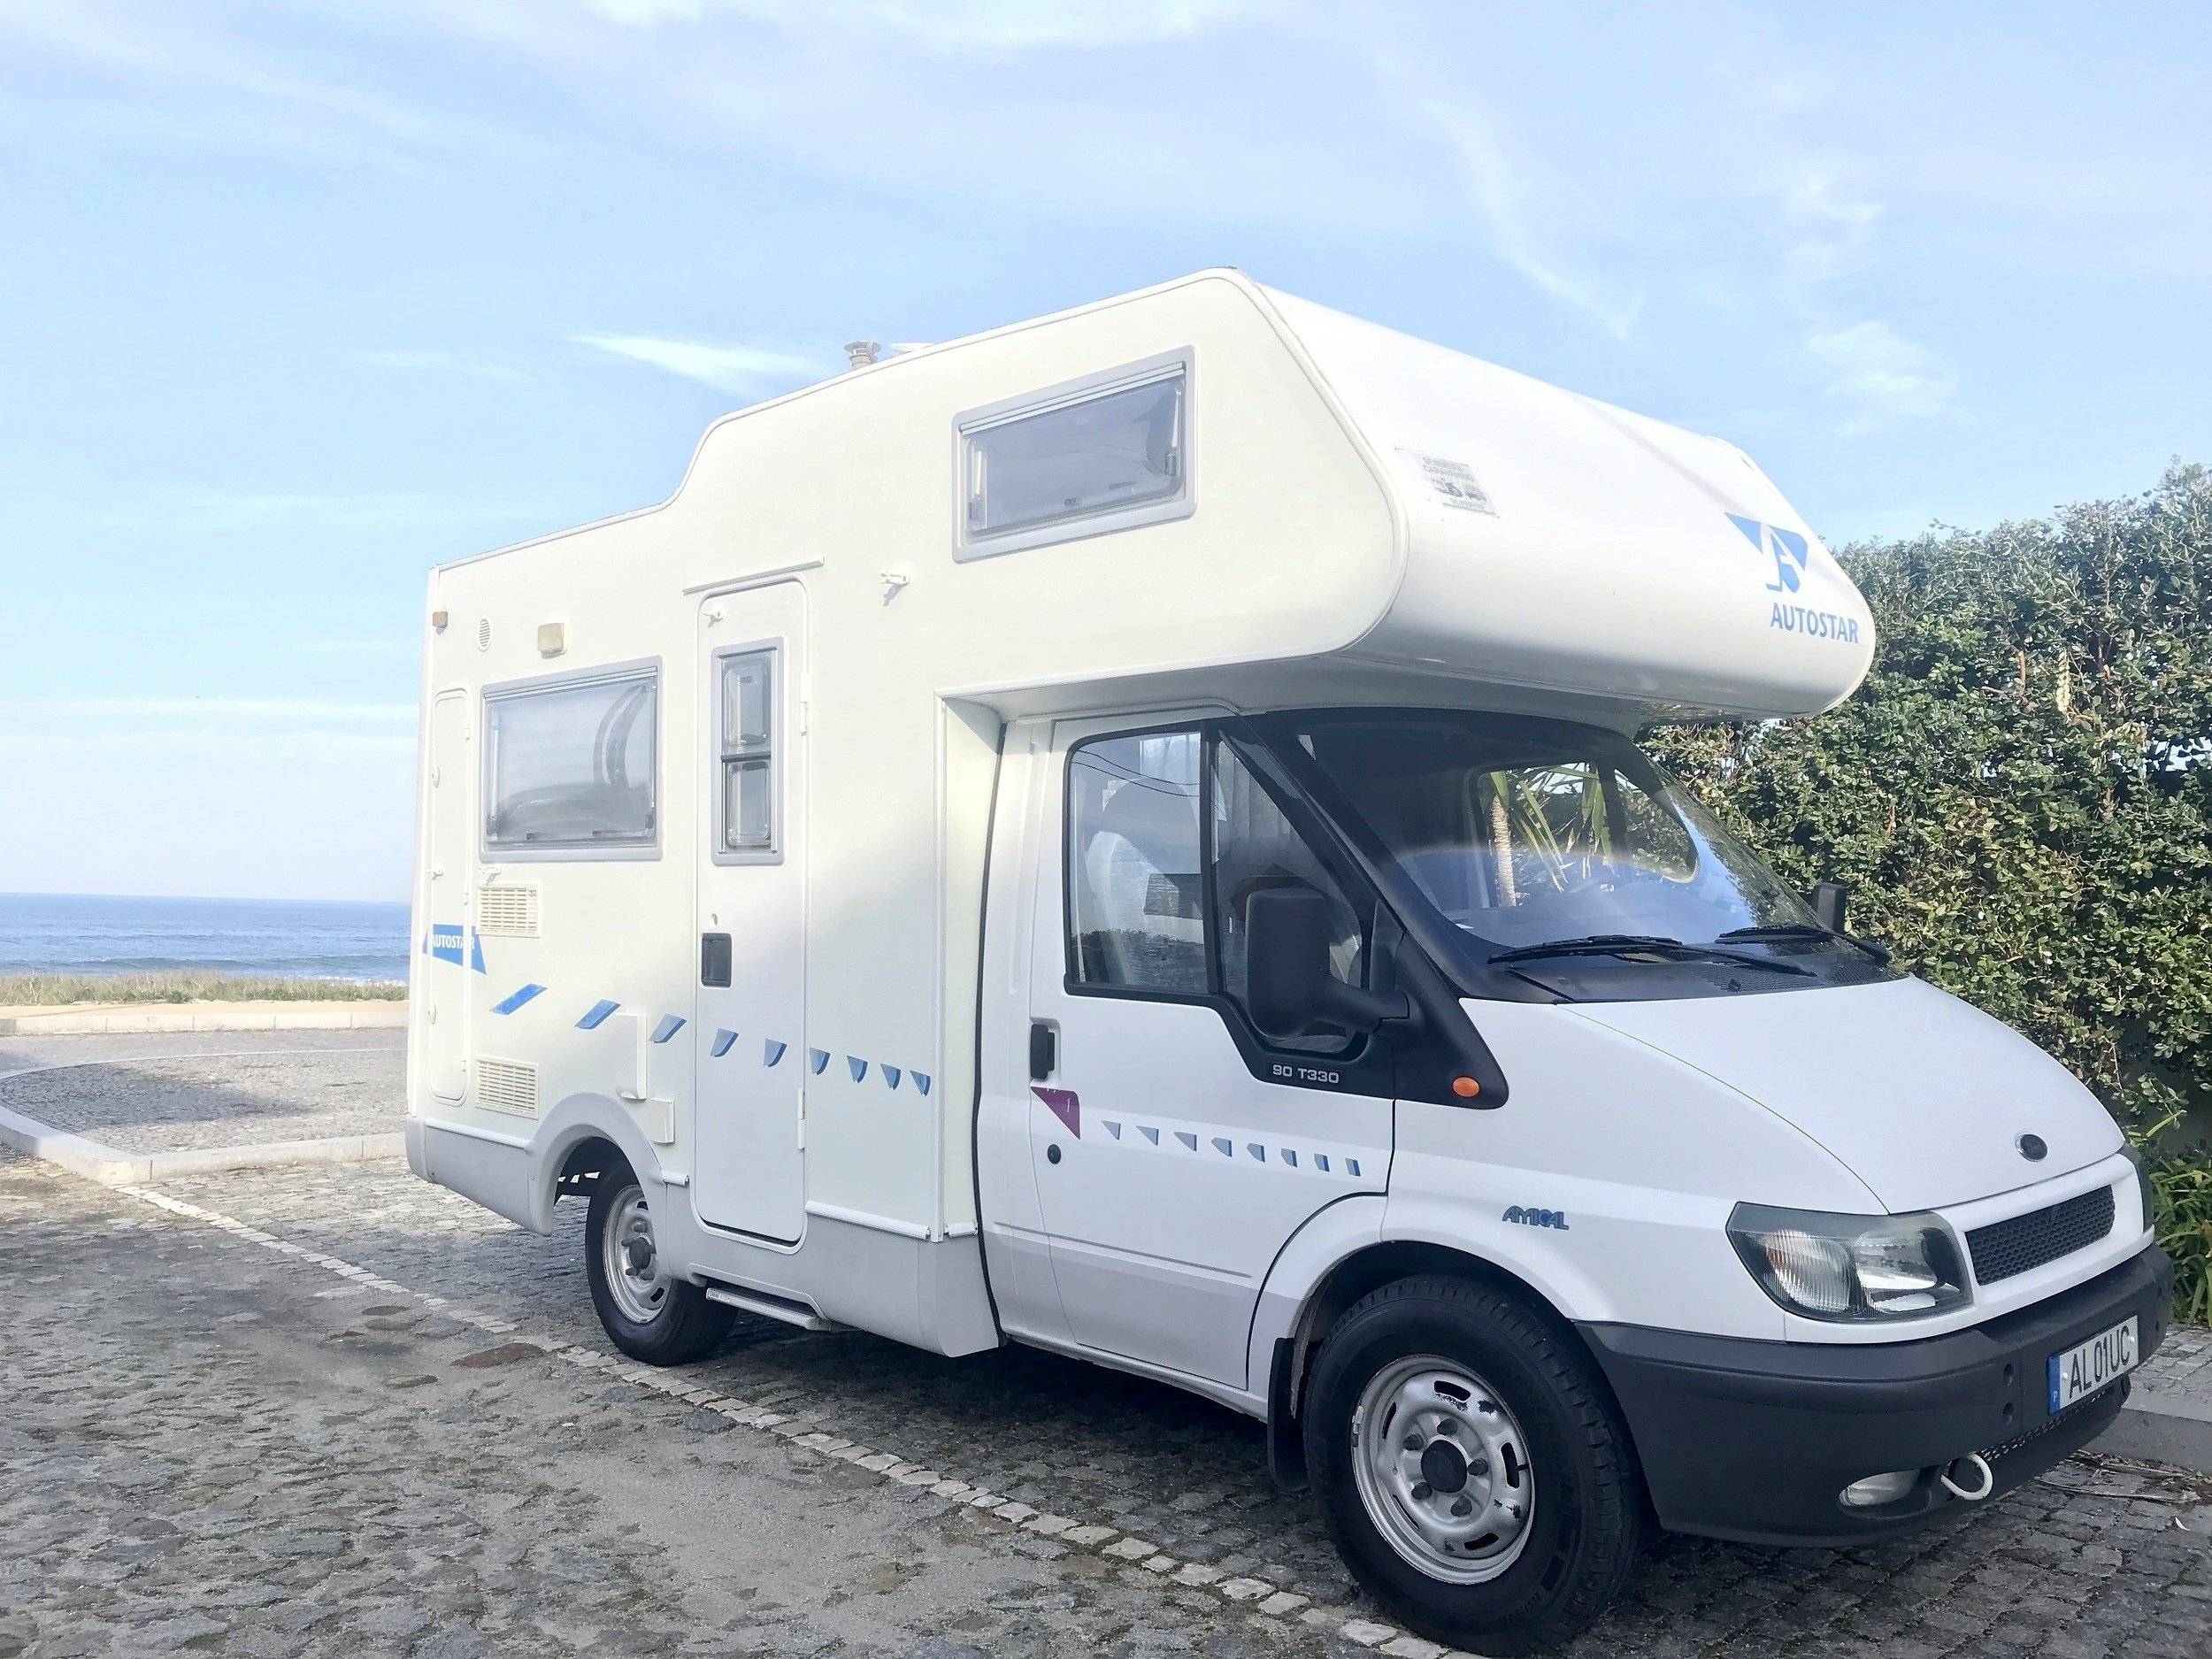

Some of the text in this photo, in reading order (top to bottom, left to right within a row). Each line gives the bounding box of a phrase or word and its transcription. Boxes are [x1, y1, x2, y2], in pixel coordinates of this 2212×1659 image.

[1770, 602, 1859, 644] AUTOSTAR
[1272, 1064, 1340, 1084] 90 T330
[2069, 1348, 2092, 1399] AL
